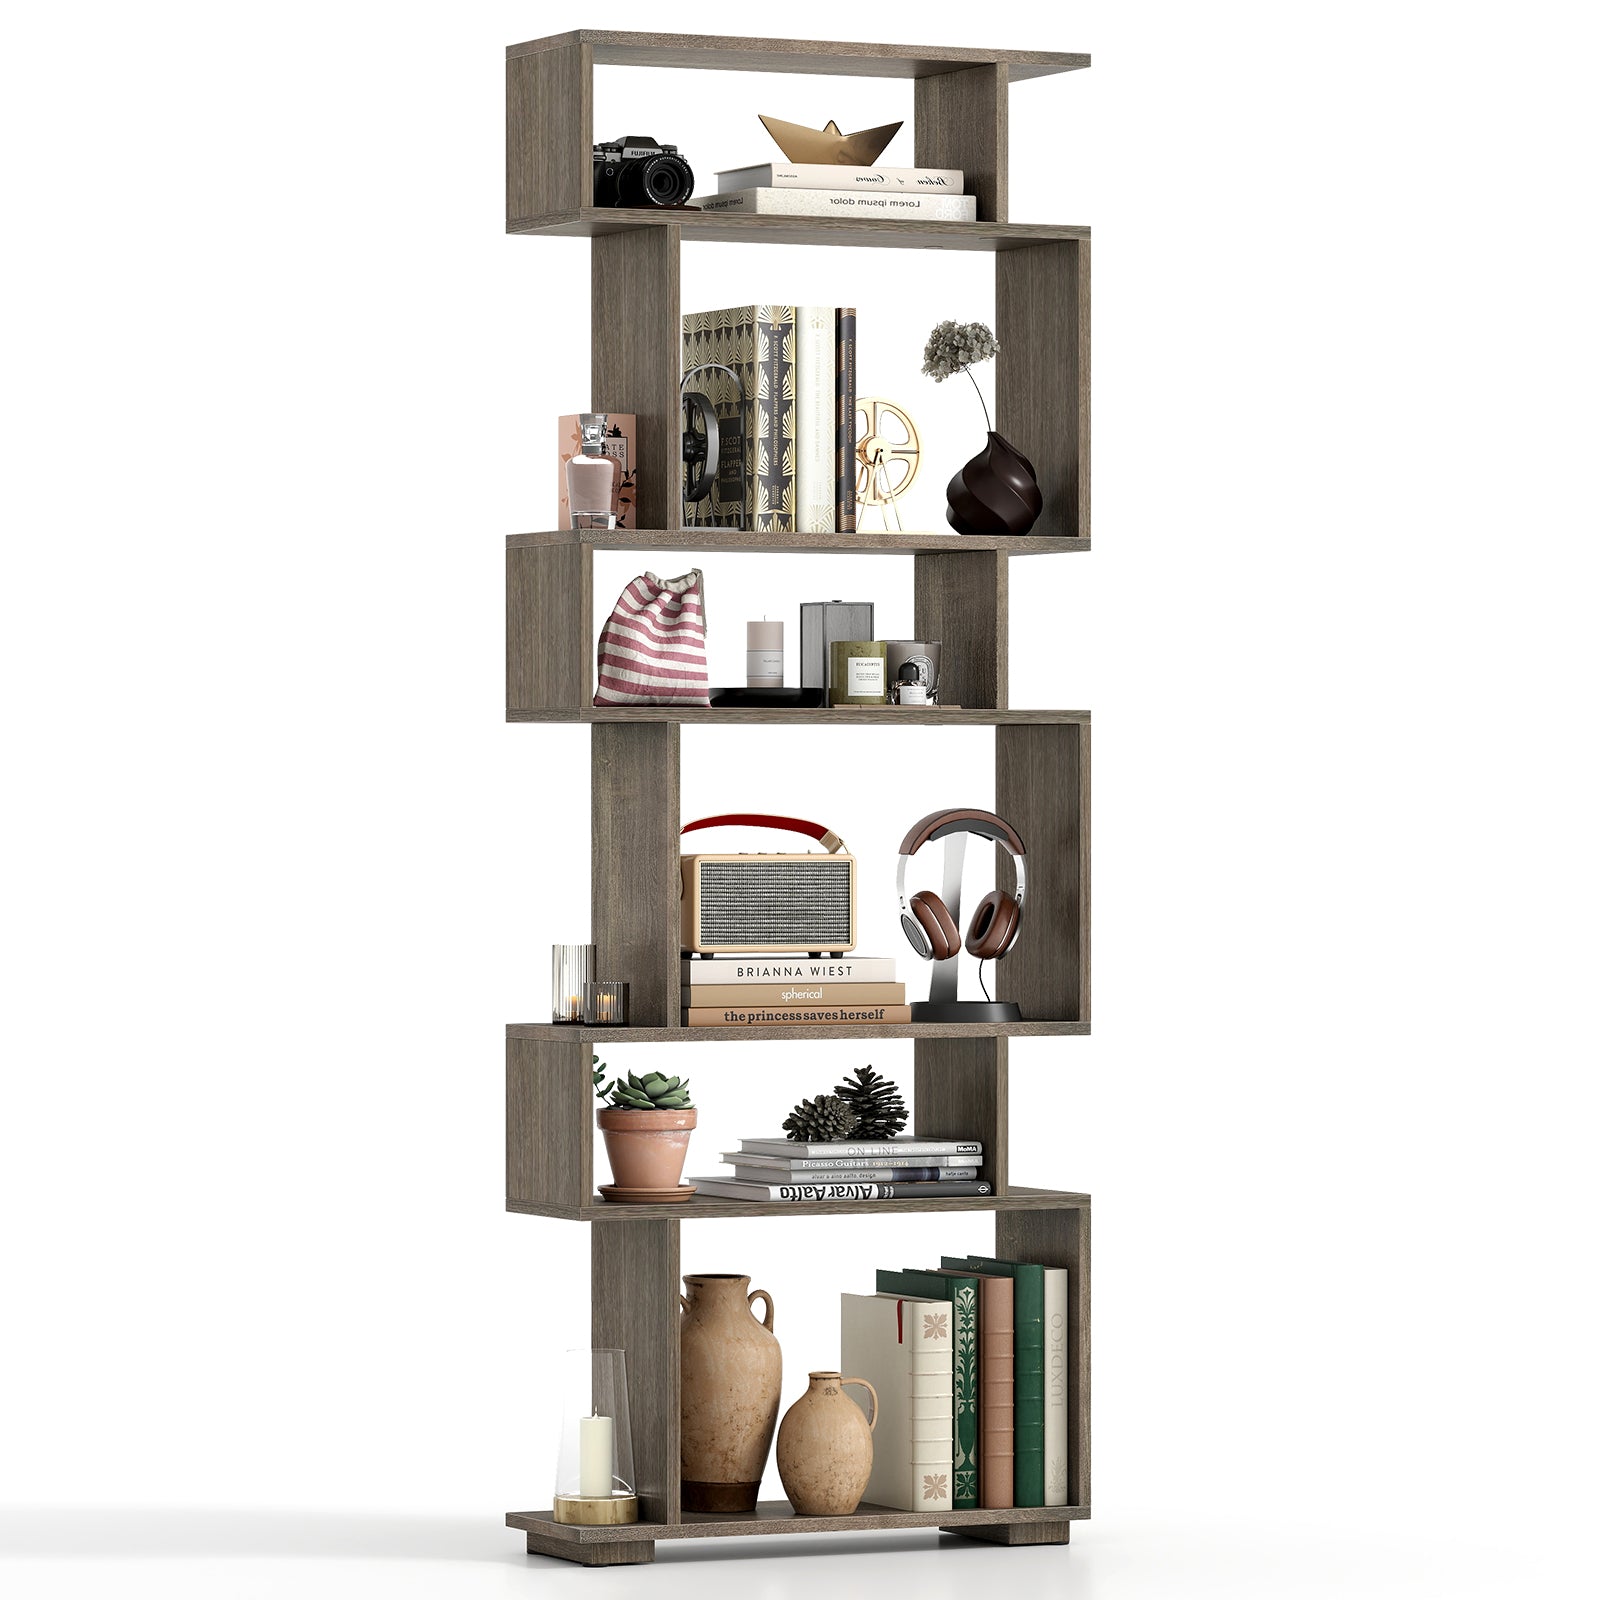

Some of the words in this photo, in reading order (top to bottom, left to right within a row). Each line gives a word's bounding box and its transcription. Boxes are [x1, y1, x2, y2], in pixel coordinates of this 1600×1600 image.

[737, 967, 803, 977] BRIANNA
[810, 966, 853, 977] WIEST
[781, 987, 823, 1002] spherical
[724, 1011, 746, 1022] the
[747, 1010, 802, 1025] princess
[802, 1011, 838, 1021] saves
[839, 1009, 885, 1021] herself
[847, 1147, 865, 1156] ON
[870, 1146, 899, 1156] LINE
[802, 1160, 834, 1168] Picasso
[835, 1159, 869, 1167] Guitars
[1051, 1313, 1063, 1408] LUXDECO
